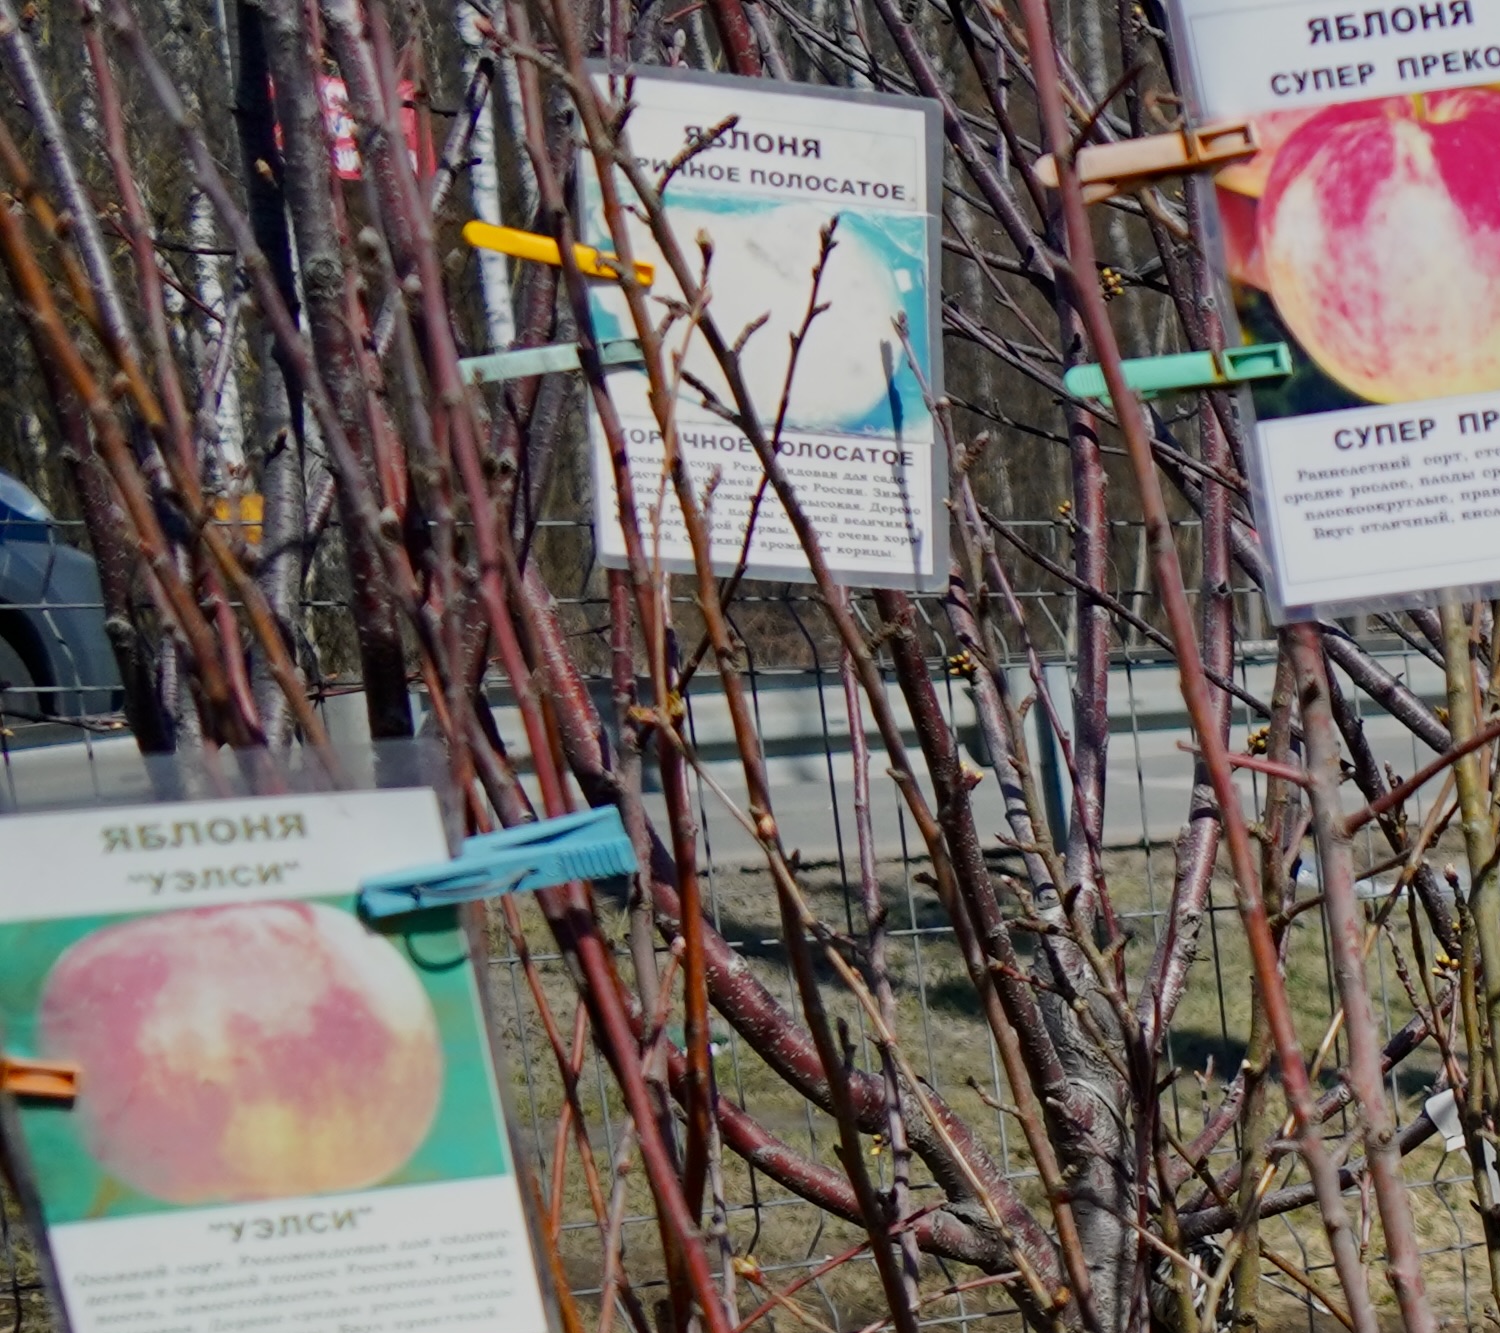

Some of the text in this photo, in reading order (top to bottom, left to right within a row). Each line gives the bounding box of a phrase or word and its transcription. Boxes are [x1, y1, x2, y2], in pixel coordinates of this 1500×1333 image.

[1305, 0, 1475, 45] ЯБЛОНЯ
[1267, 62, 1379, 96] СУПЕР
[750, 167, 906, 201] ПОЛОСАТОЕ
[1331, 415, 1438, 452] СУПЕР
[780, 440, 915, 467] ОЛОСАТОЕ
[98, 810, 312, 854] ЯБЛОНЯ
[125, 859, 304, 897] "УЭЛСИ"
[205, 1201, 379, 1248] "УЭЛСИ"
